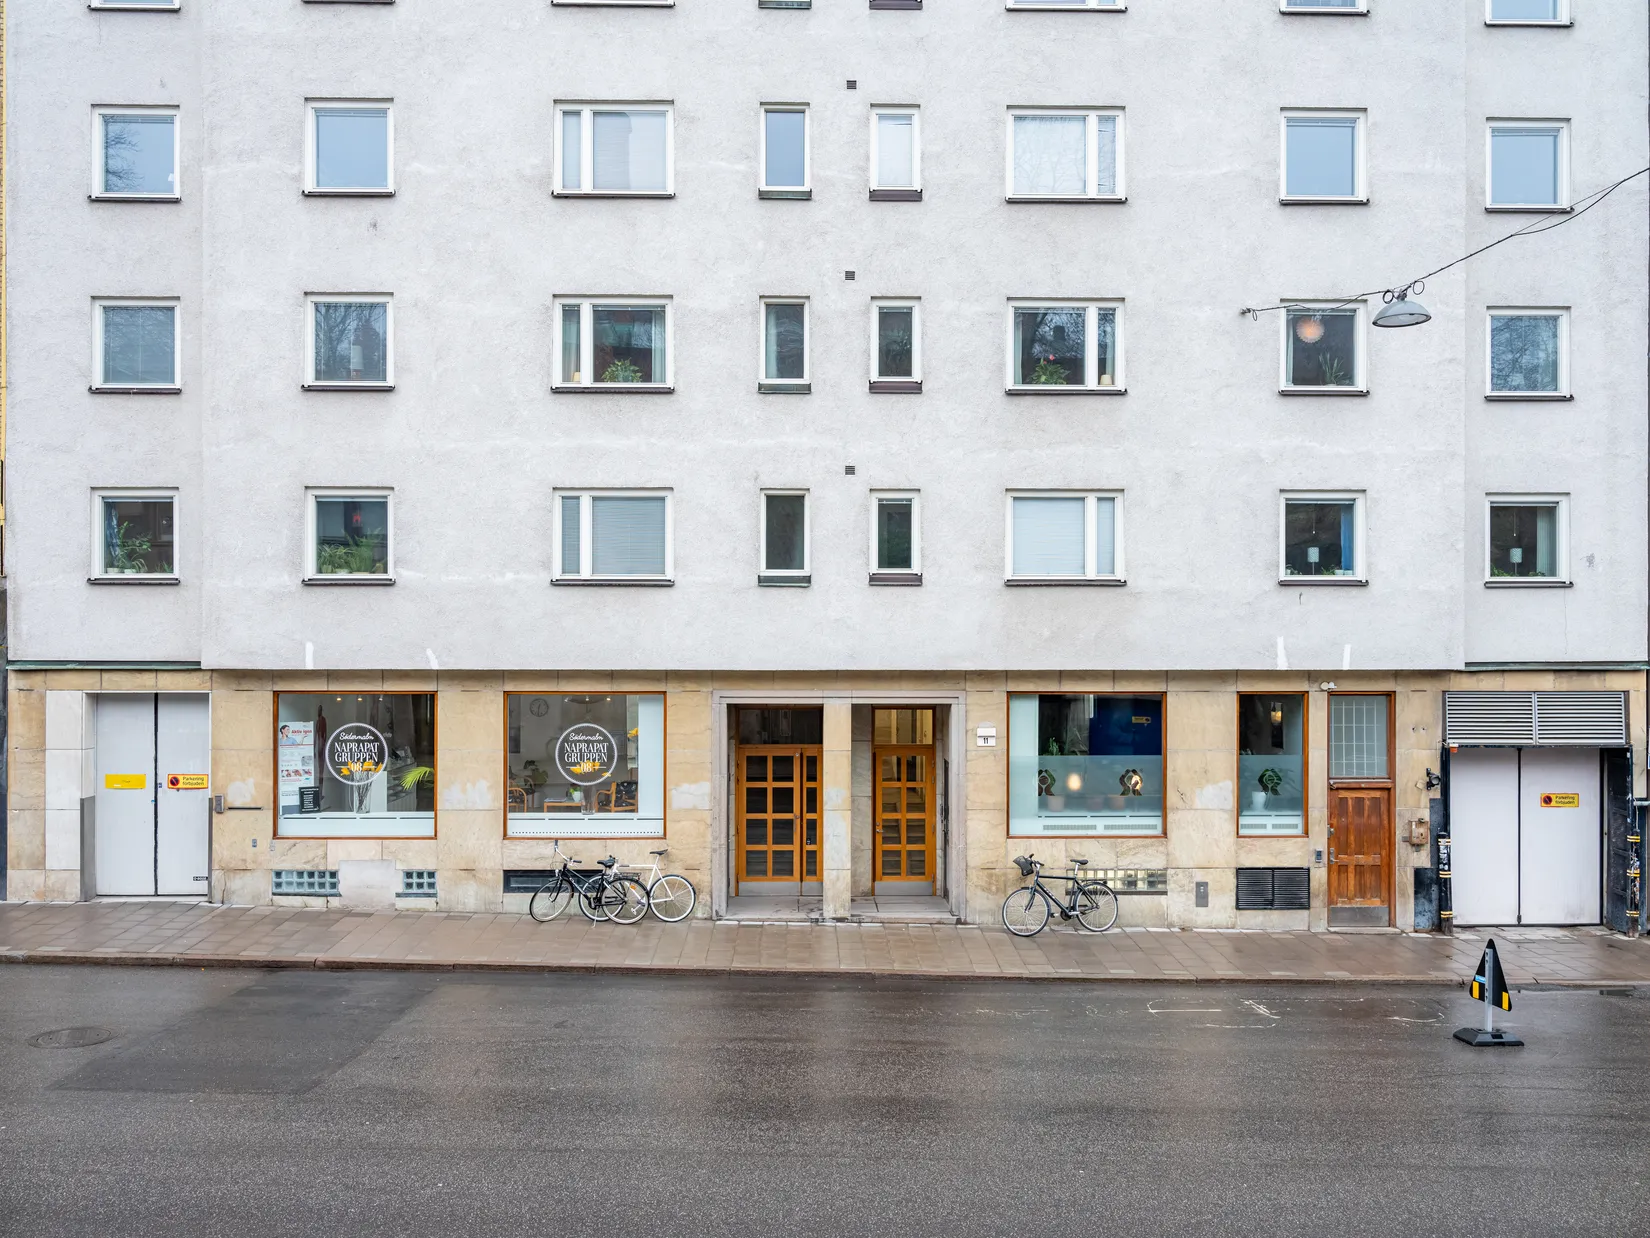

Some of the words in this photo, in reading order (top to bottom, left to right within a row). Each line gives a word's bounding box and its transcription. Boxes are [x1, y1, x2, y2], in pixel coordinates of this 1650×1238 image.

[340, 732, 374, 740] Södermalm
[569, 732, 603, 740] Södermalm
[334, 742, 379, 752] NAPRAPAT
[564, 742, 609, 752] NAPRAPAT
[334, 752, 379, 762] GRUPPEN
[564, 752, 608, 762] GRUPPEN
[351, 762, 363, 772] 08
[580, 762, 592, 773] 08
